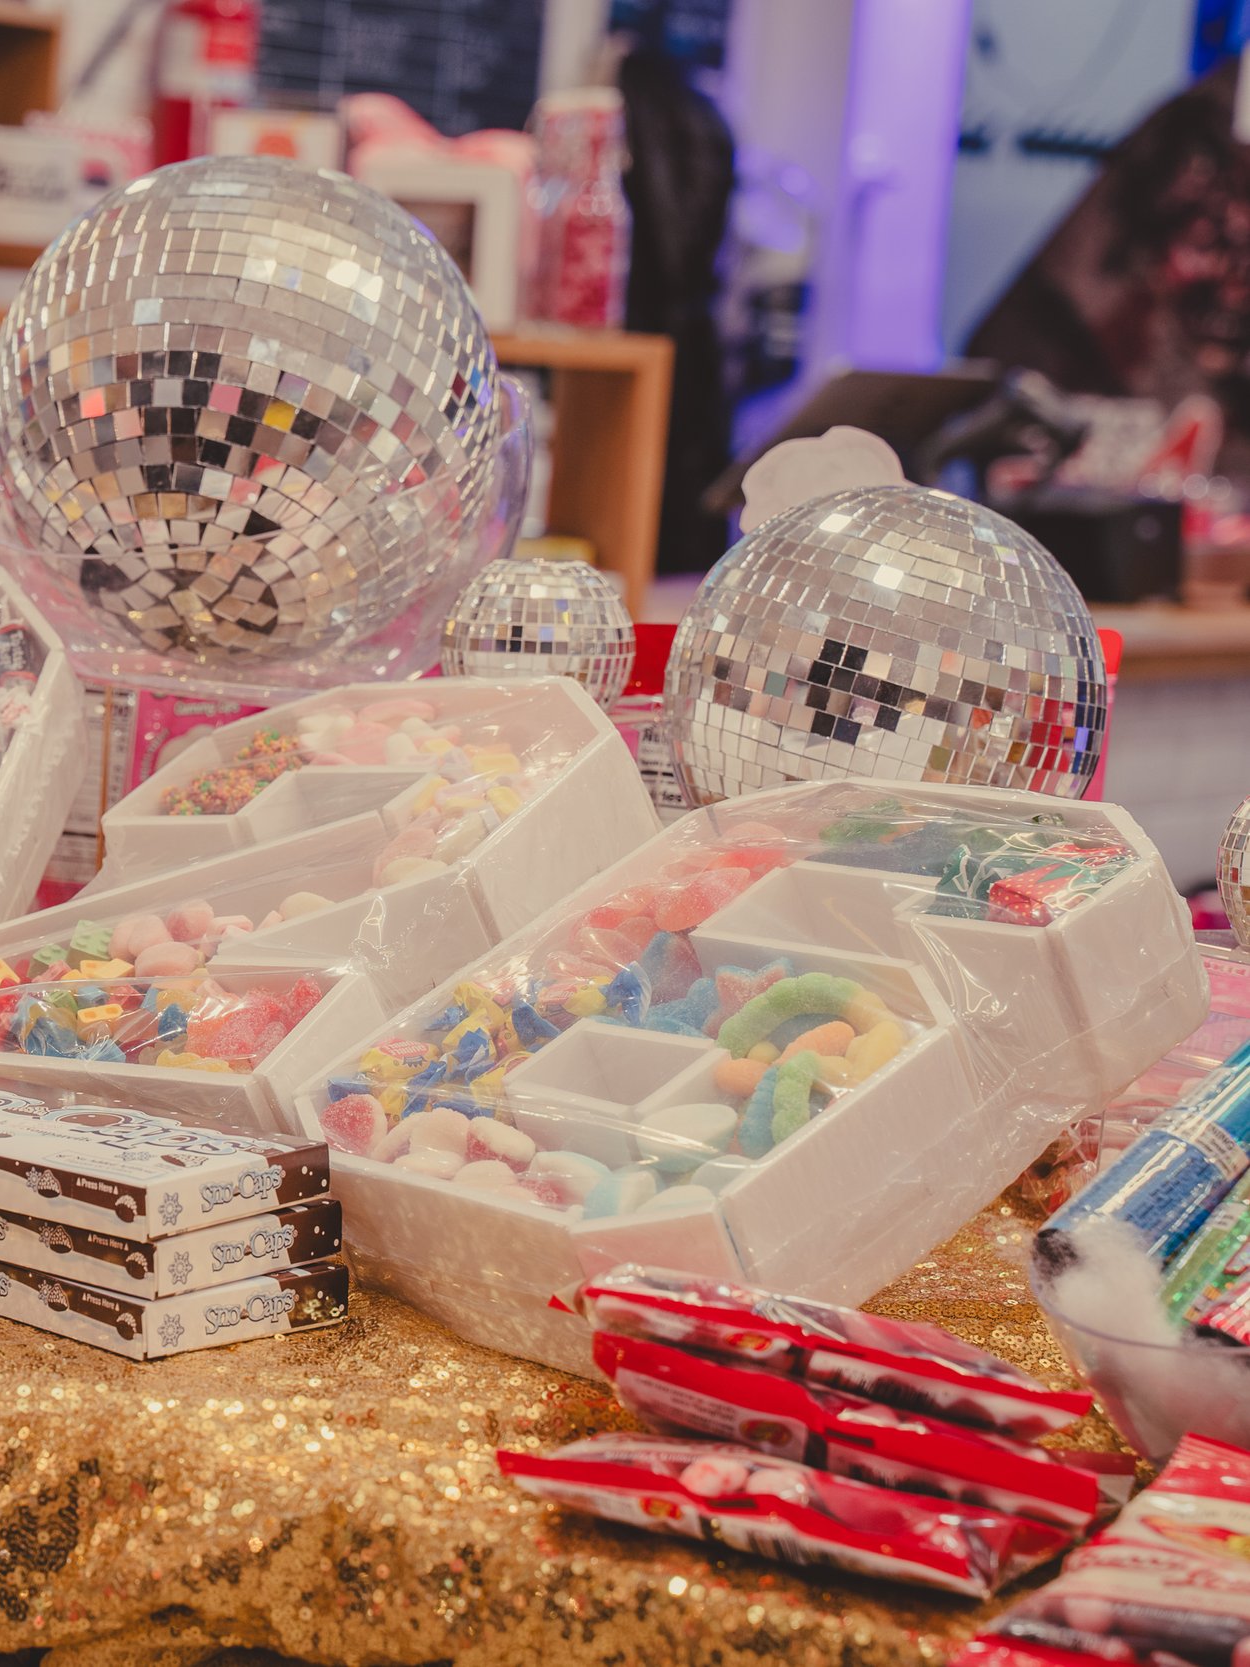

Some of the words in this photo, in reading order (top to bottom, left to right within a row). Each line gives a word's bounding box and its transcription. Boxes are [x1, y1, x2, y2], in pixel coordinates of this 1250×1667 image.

[81, 1178, 98, 1191] Press
[98, 1182, 113, 1194] Here
[93, 1234, 109, 1247] Press
[108, 1237, 123, 1250] Here
[86, 1294, 101, 1306] Press
[101, 1297, 115, 1310] Here
